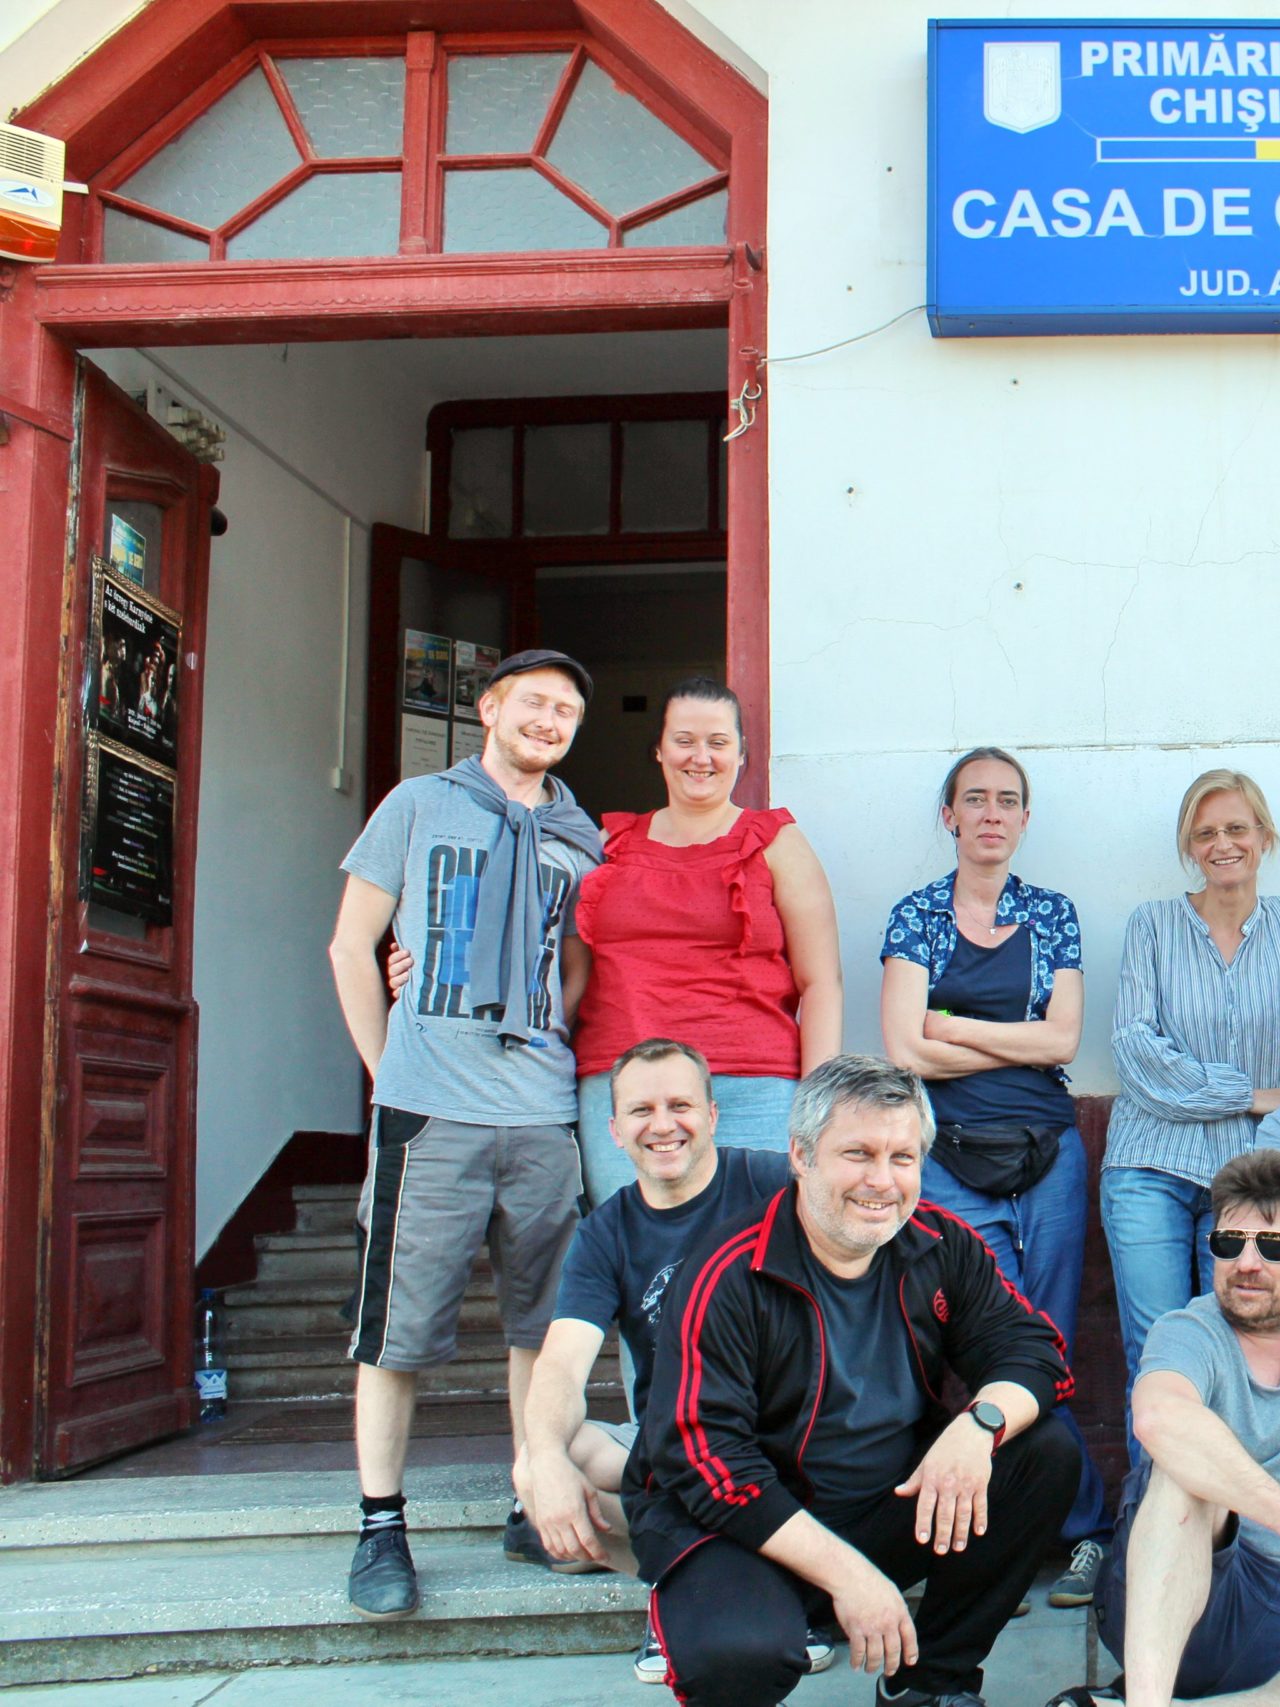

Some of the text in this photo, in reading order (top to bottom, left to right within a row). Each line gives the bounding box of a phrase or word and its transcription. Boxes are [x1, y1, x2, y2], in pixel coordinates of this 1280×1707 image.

[952, 188, 1143, 238] CASA
[1163, 188, 1253, 236] DE
[1179, 270, 1261, 297] JUD.
